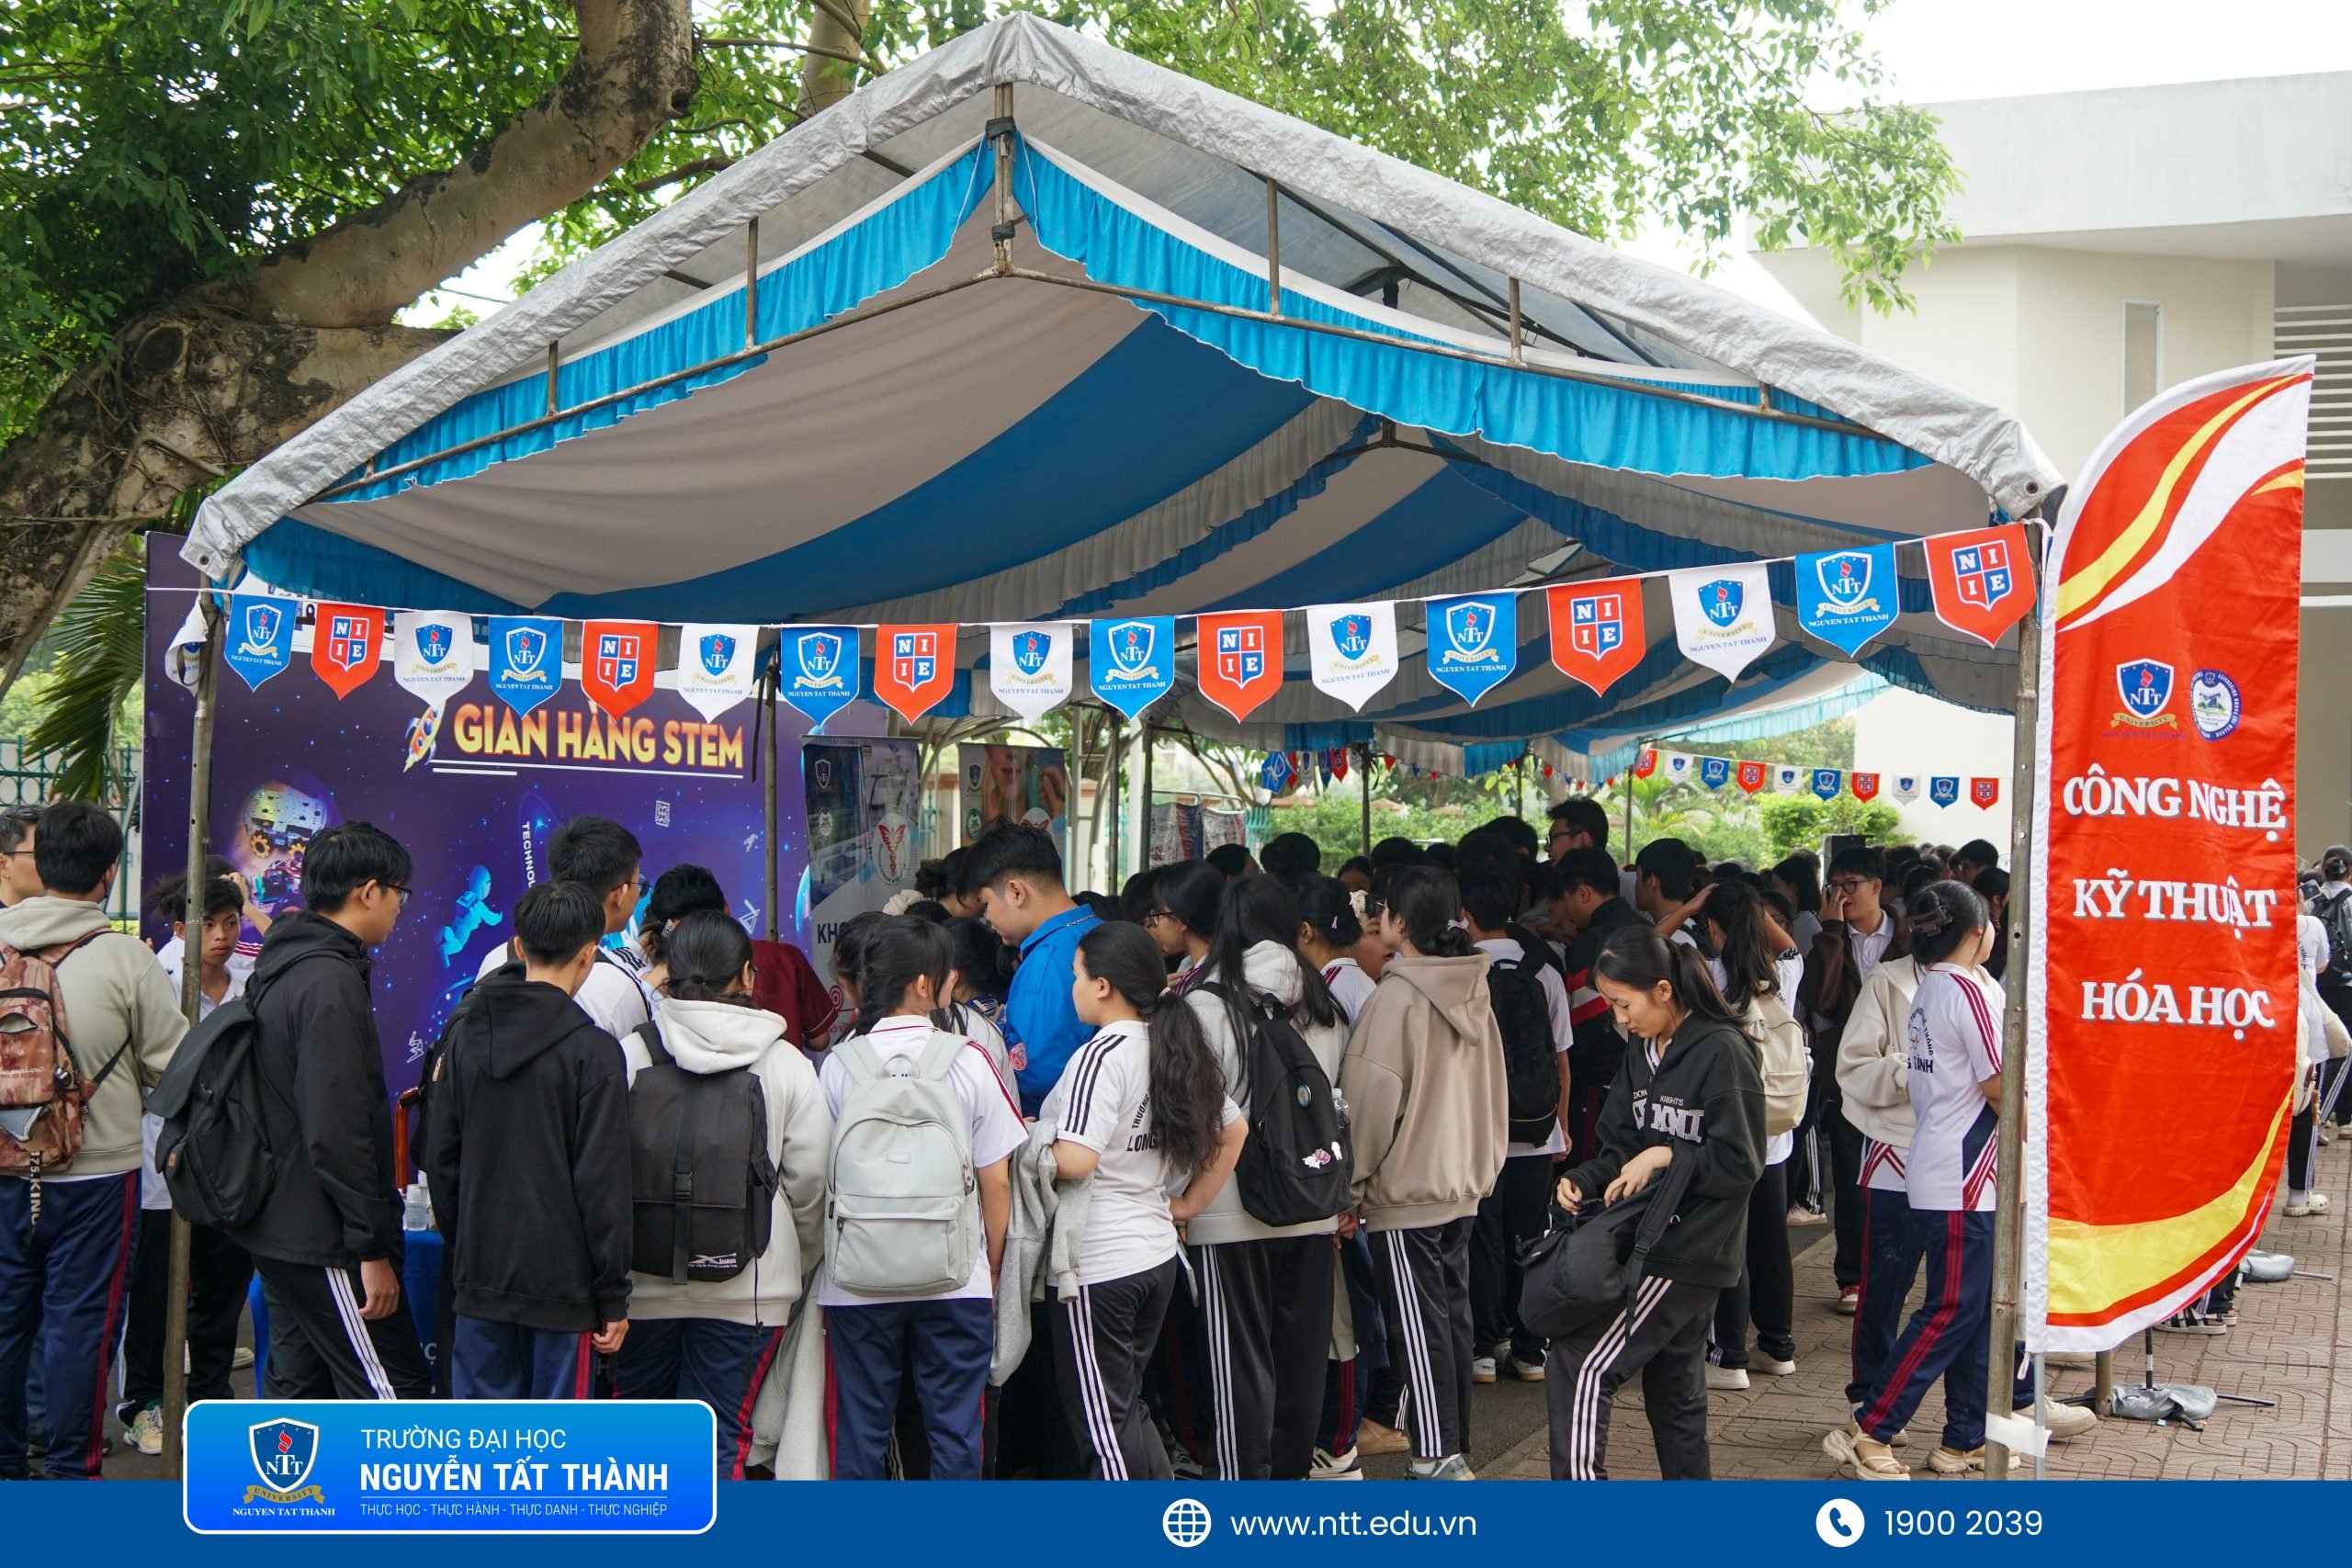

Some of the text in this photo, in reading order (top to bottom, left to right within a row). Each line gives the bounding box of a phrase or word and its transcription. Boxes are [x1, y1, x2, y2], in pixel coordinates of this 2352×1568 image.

[1808, 618, 1842, 627] NGUYEN
[1860, 614, 1889, 622] THANH
[1690, 643, 1722, 652] NGUYEN
[1739, 637, 1767, 645] THANH
[2130, 688, 2162, 705] NTT
[454, 699, 743, 769] GIAN HÀNG STEM
[2063, 763, 2287, 841] CÔNG NGHỆ
[2073, 868, 2278, 940] KỸ THUẬT
[818, 921, 849, 944] KH
[2081, 967, 2276, 1040] HÓA HỌC
[1660, 1095, 1684, 1106] KNIGHTS
